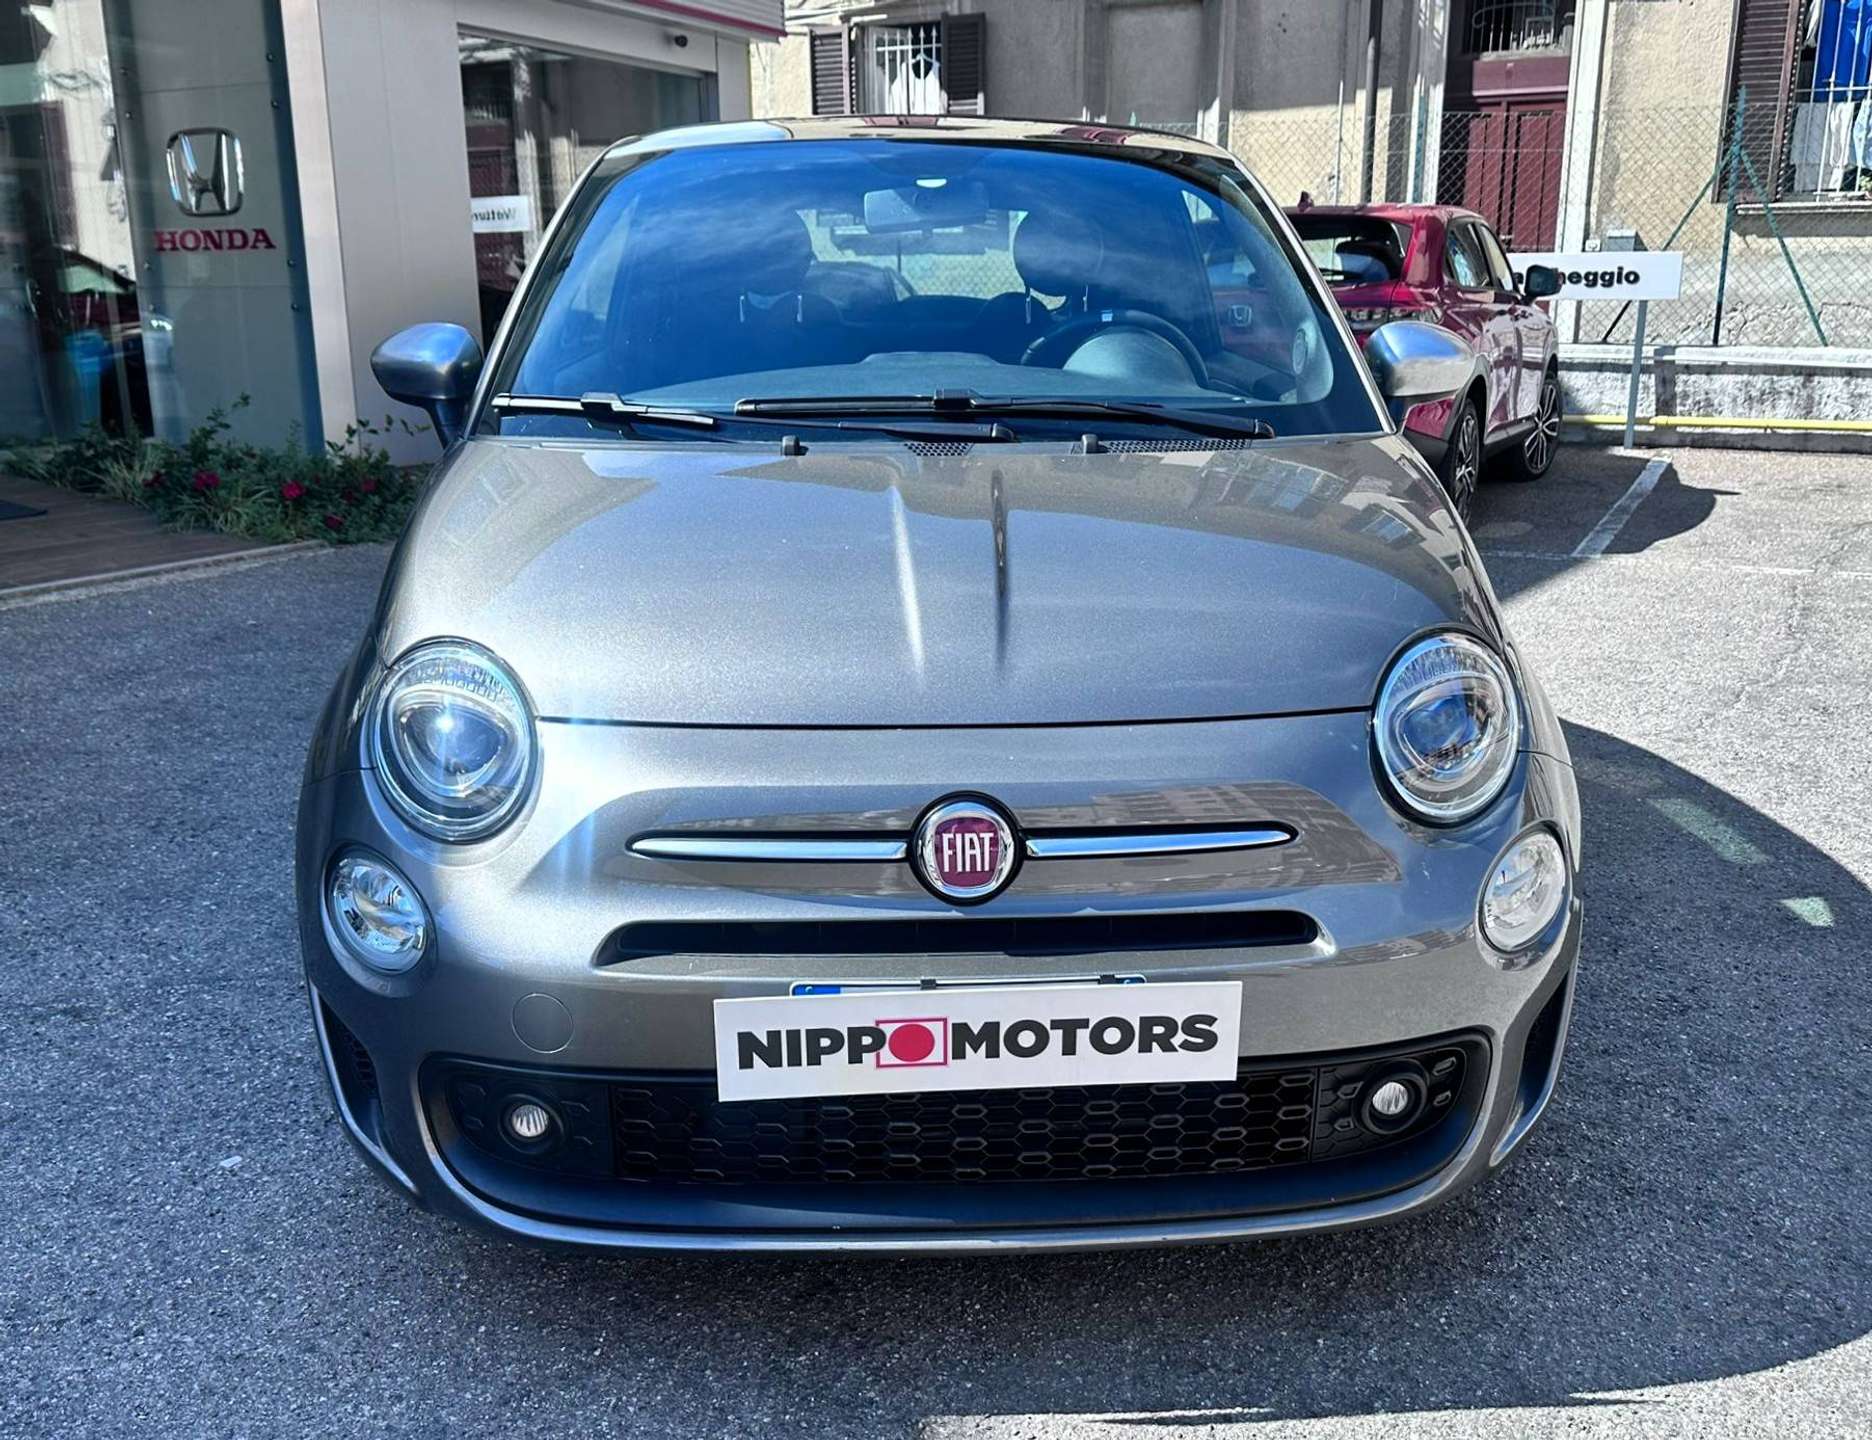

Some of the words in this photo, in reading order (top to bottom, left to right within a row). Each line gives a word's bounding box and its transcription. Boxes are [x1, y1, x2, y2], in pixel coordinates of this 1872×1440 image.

[154, 227, 276, 251] HONDA
[942, 832, 995, 873] FIAT
[951, 1014, 1218, 1061] MOTORS
